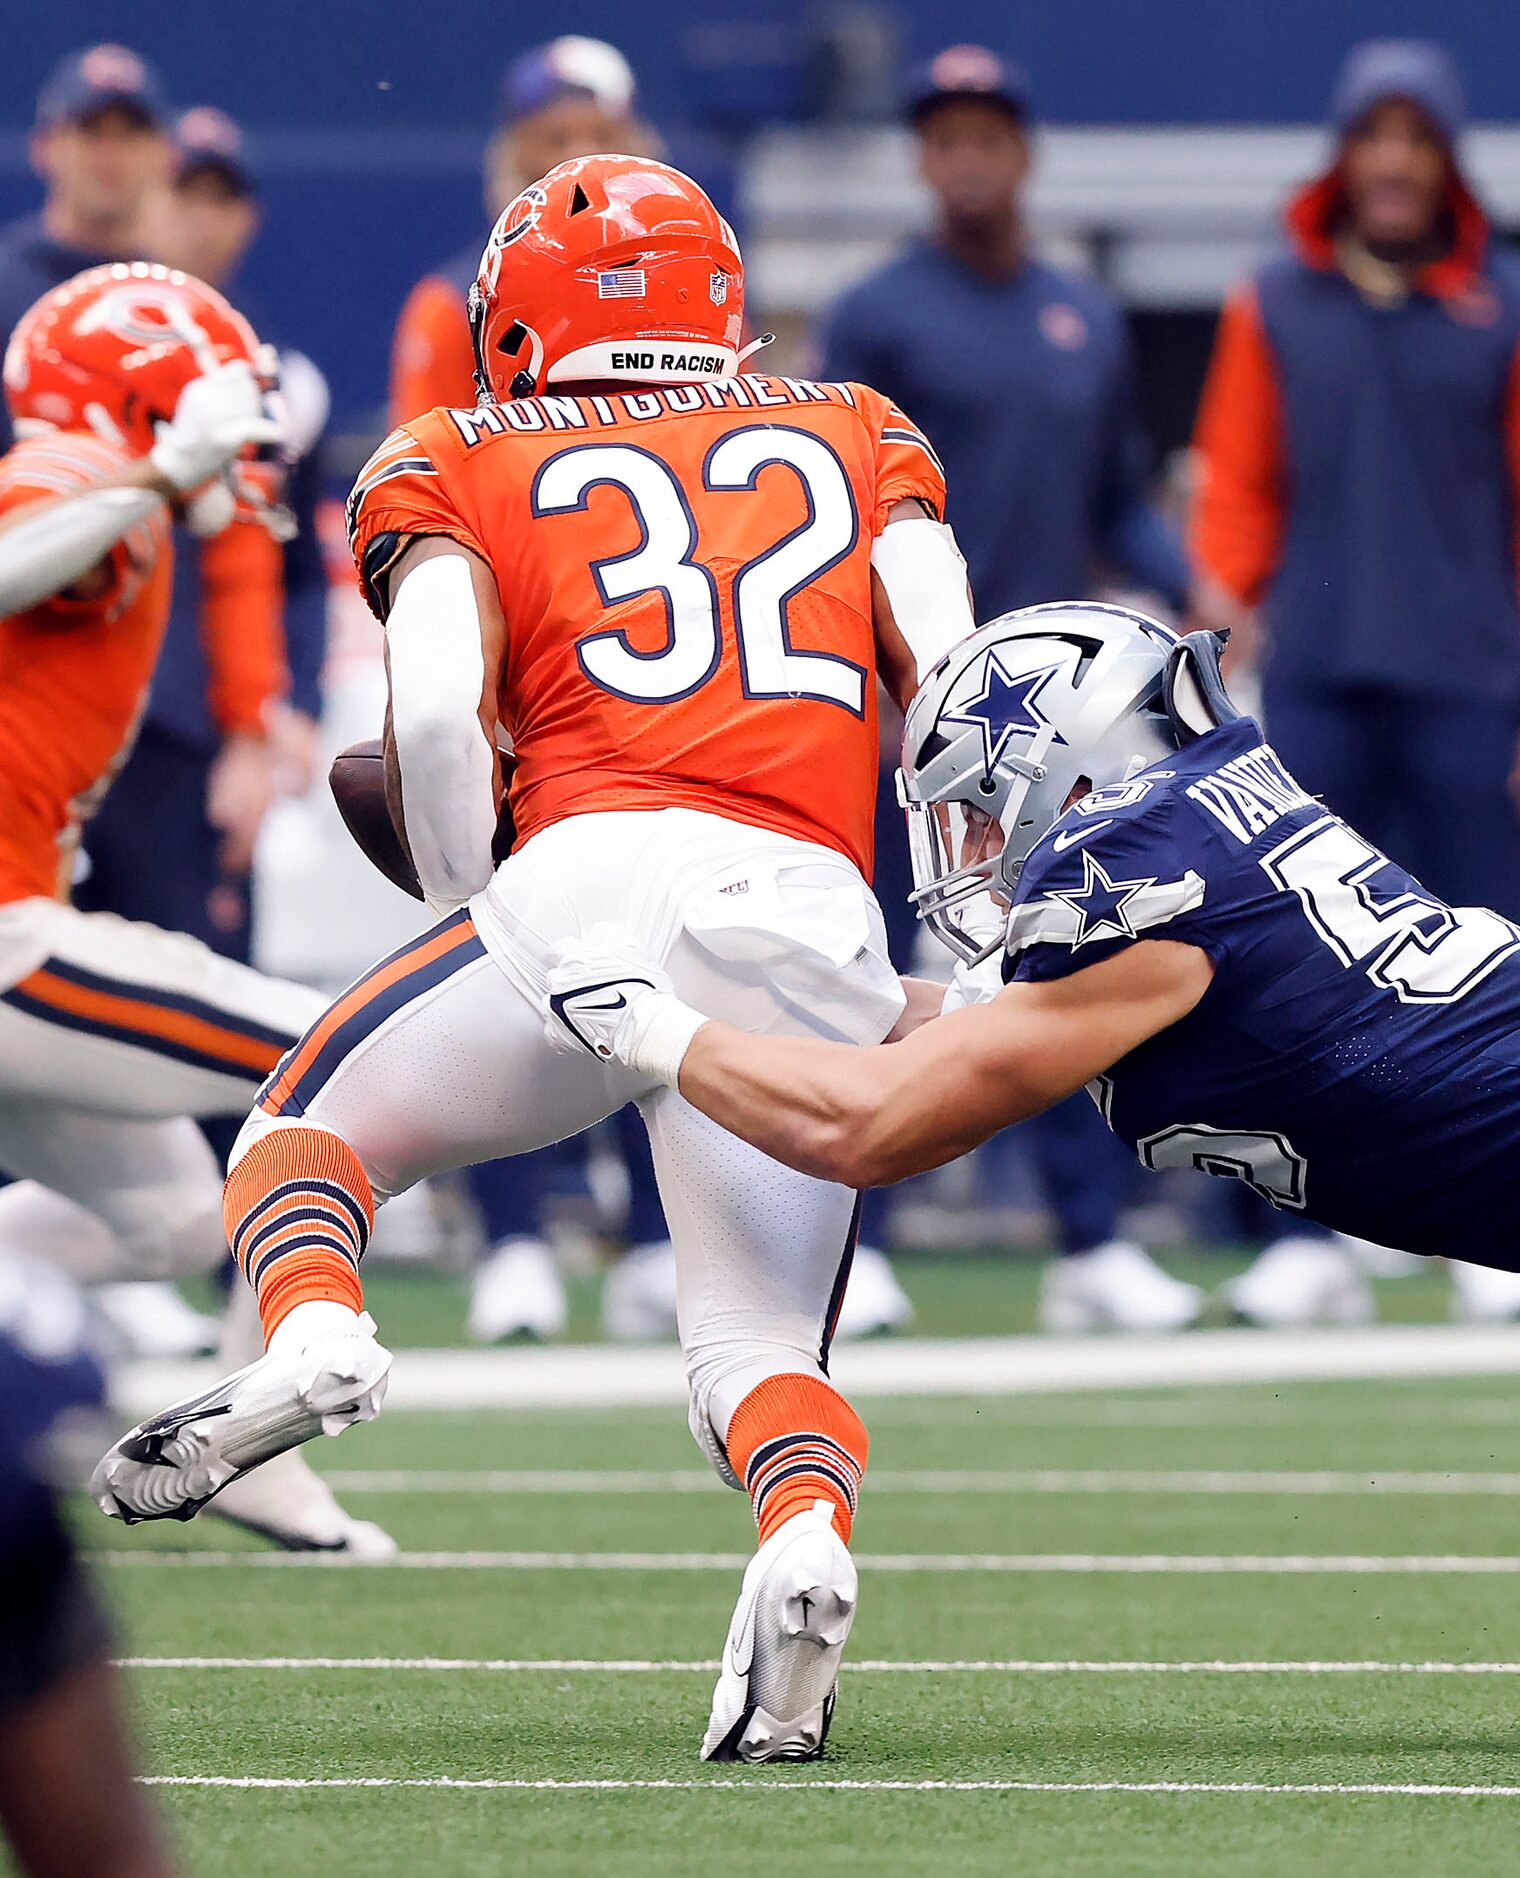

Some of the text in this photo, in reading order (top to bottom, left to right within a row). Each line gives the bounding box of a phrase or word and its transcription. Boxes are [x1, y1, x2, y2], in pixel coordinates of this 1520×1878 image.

[611, 353, 725, 375] END RACISM
[530, 423, 868, 722] 32
